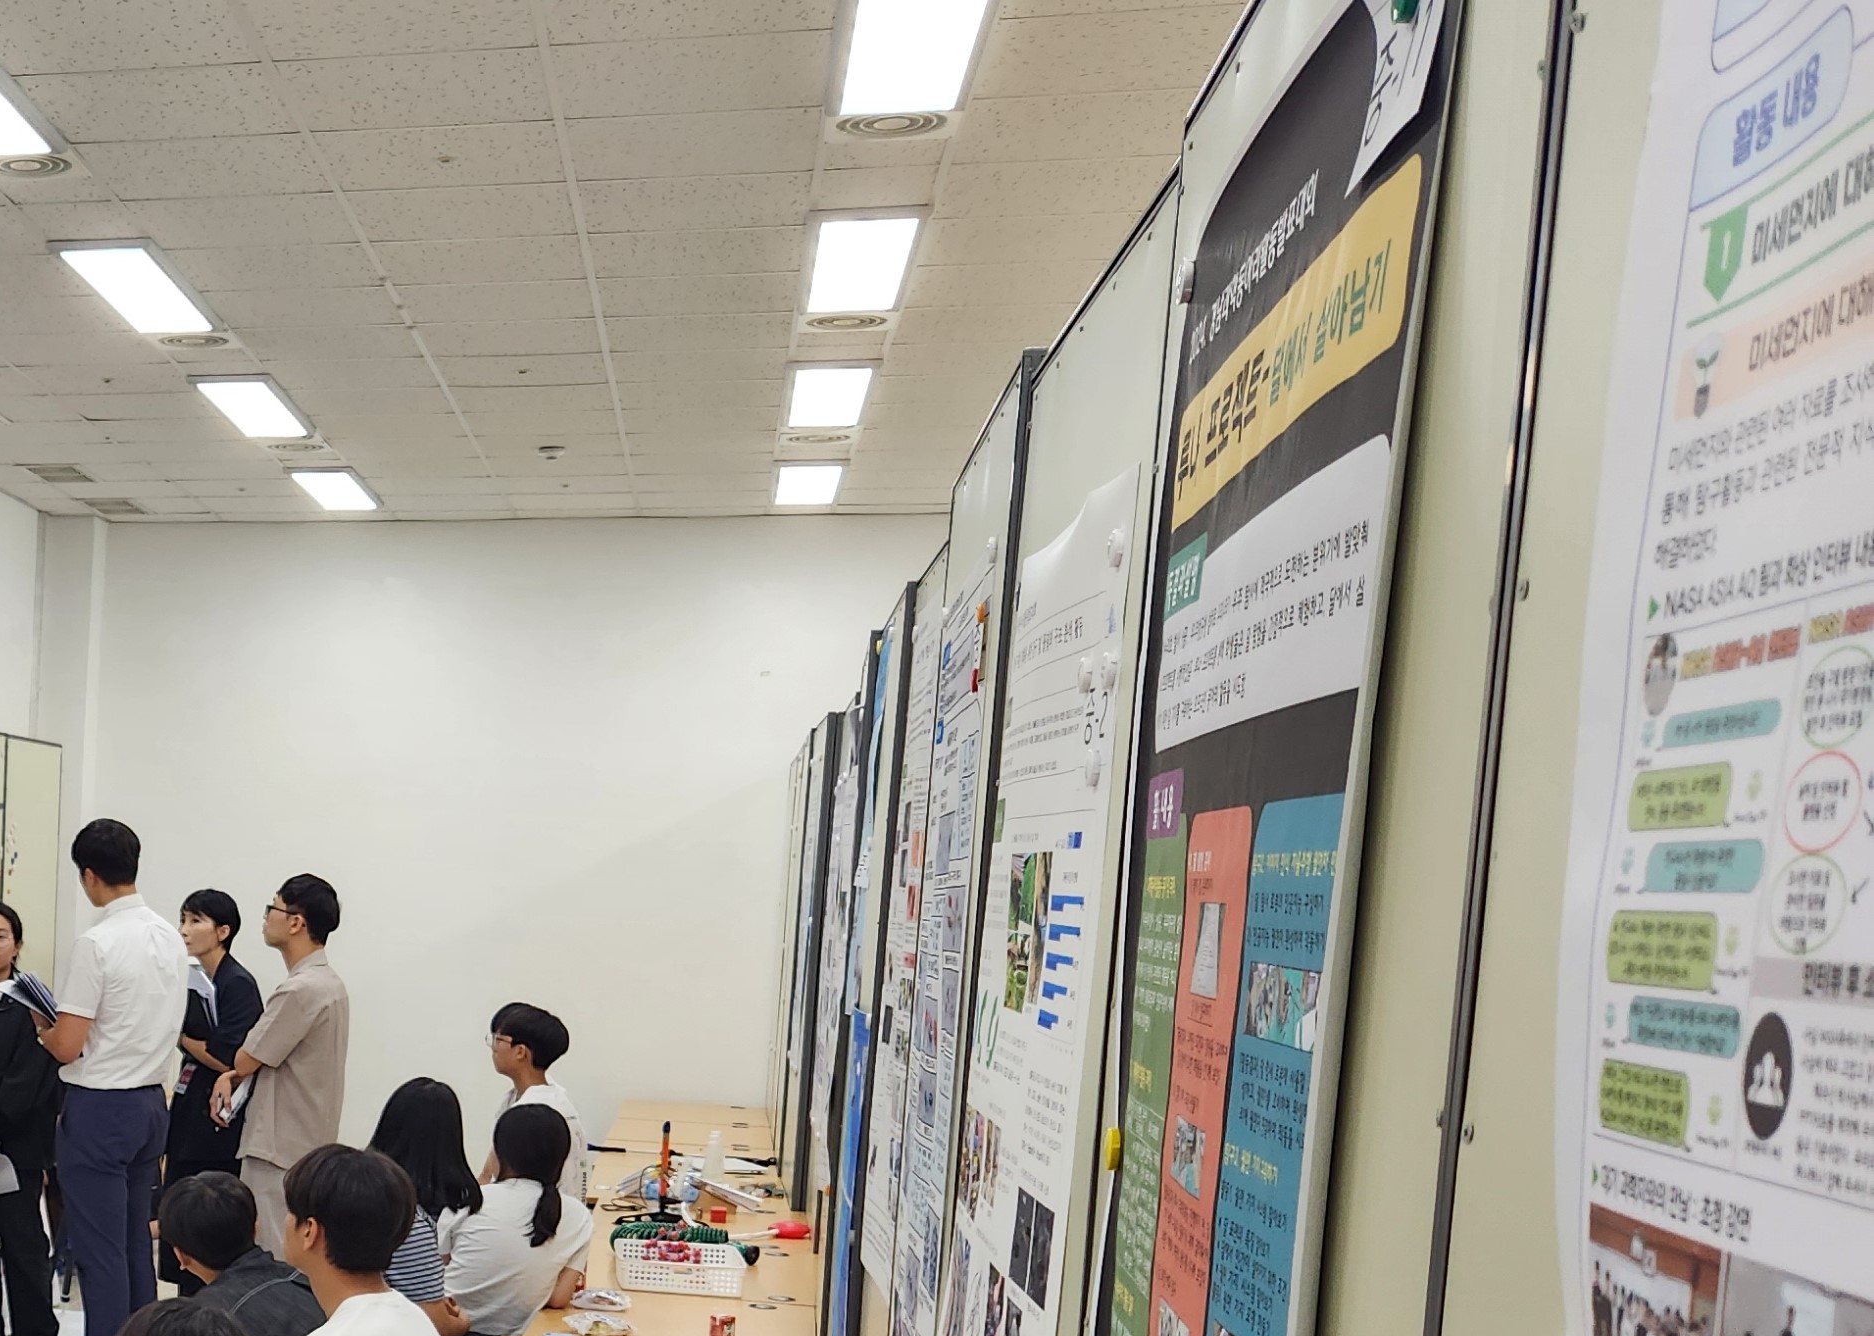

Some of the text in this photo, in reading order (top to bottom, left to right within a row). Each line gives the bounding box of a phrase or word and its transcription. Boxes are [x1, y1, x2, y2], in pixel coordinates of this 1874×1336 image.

[1733, 53, 1820, 167] 활동 내용
[1751, 169, 1839, 266] 미세먼지에
[1177, 412, 1203, 501] 루나
[1313, 239, 1391, 363] 살아남기
[1749, 294, 1835, 372] 미세먼지에
[1664, 585, 1704, 620] NASA
